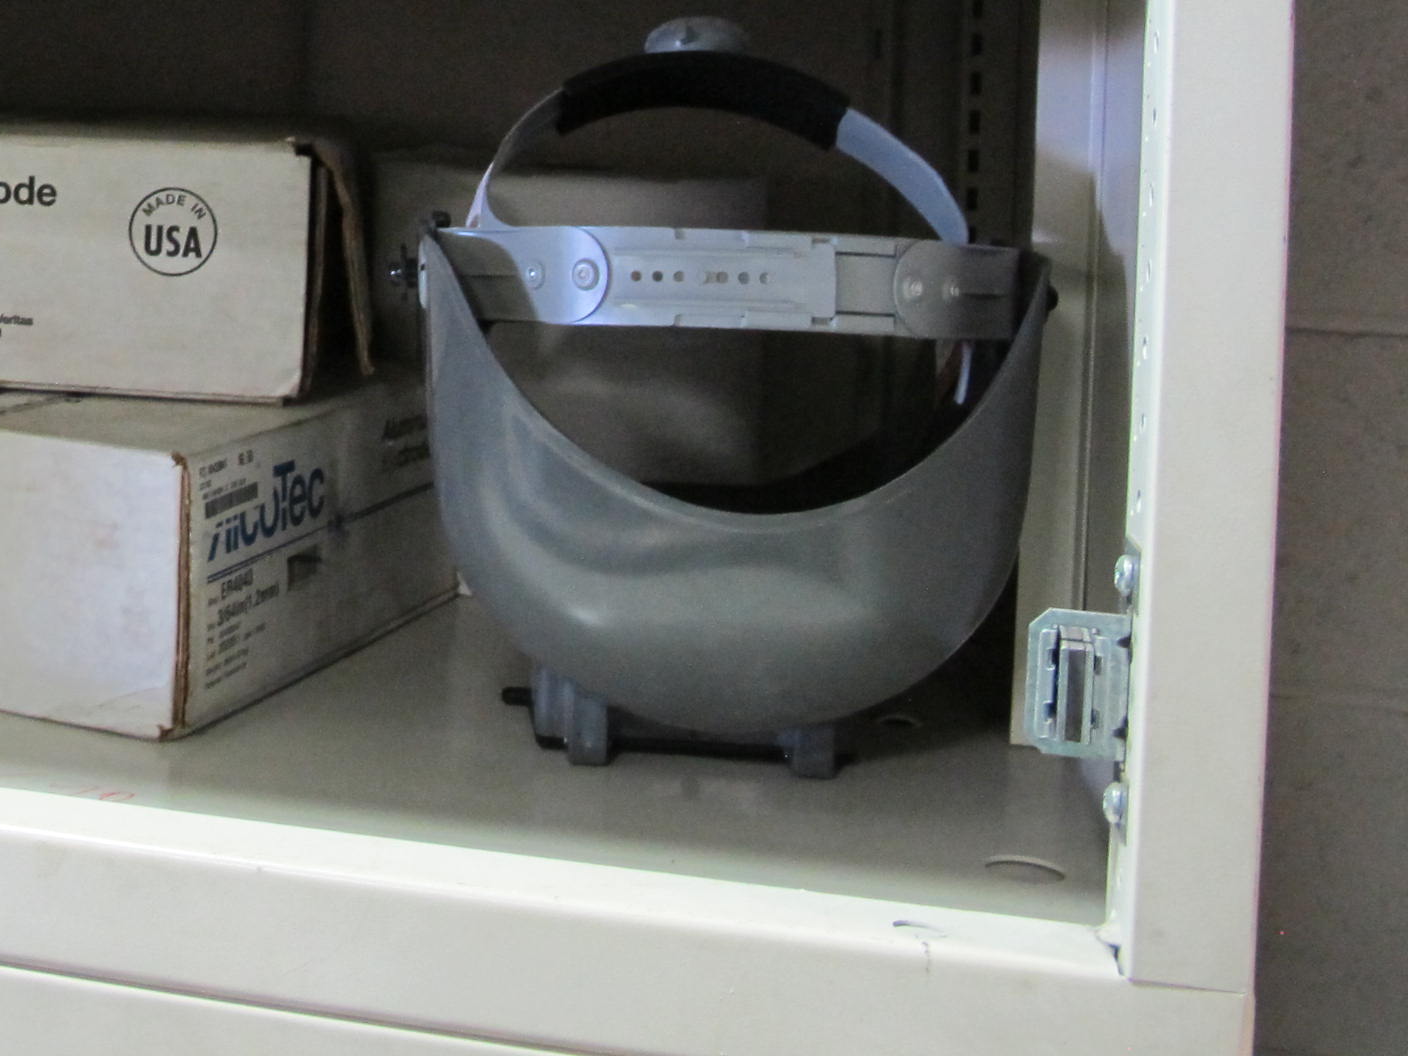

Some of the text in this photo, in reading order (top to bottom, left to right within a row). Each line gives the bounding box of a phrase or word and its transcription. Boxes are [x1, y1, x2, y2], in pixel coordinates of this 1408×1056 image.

[143, 194, 206, 220] MADE IN
[144, 224, 202, 258] USA
